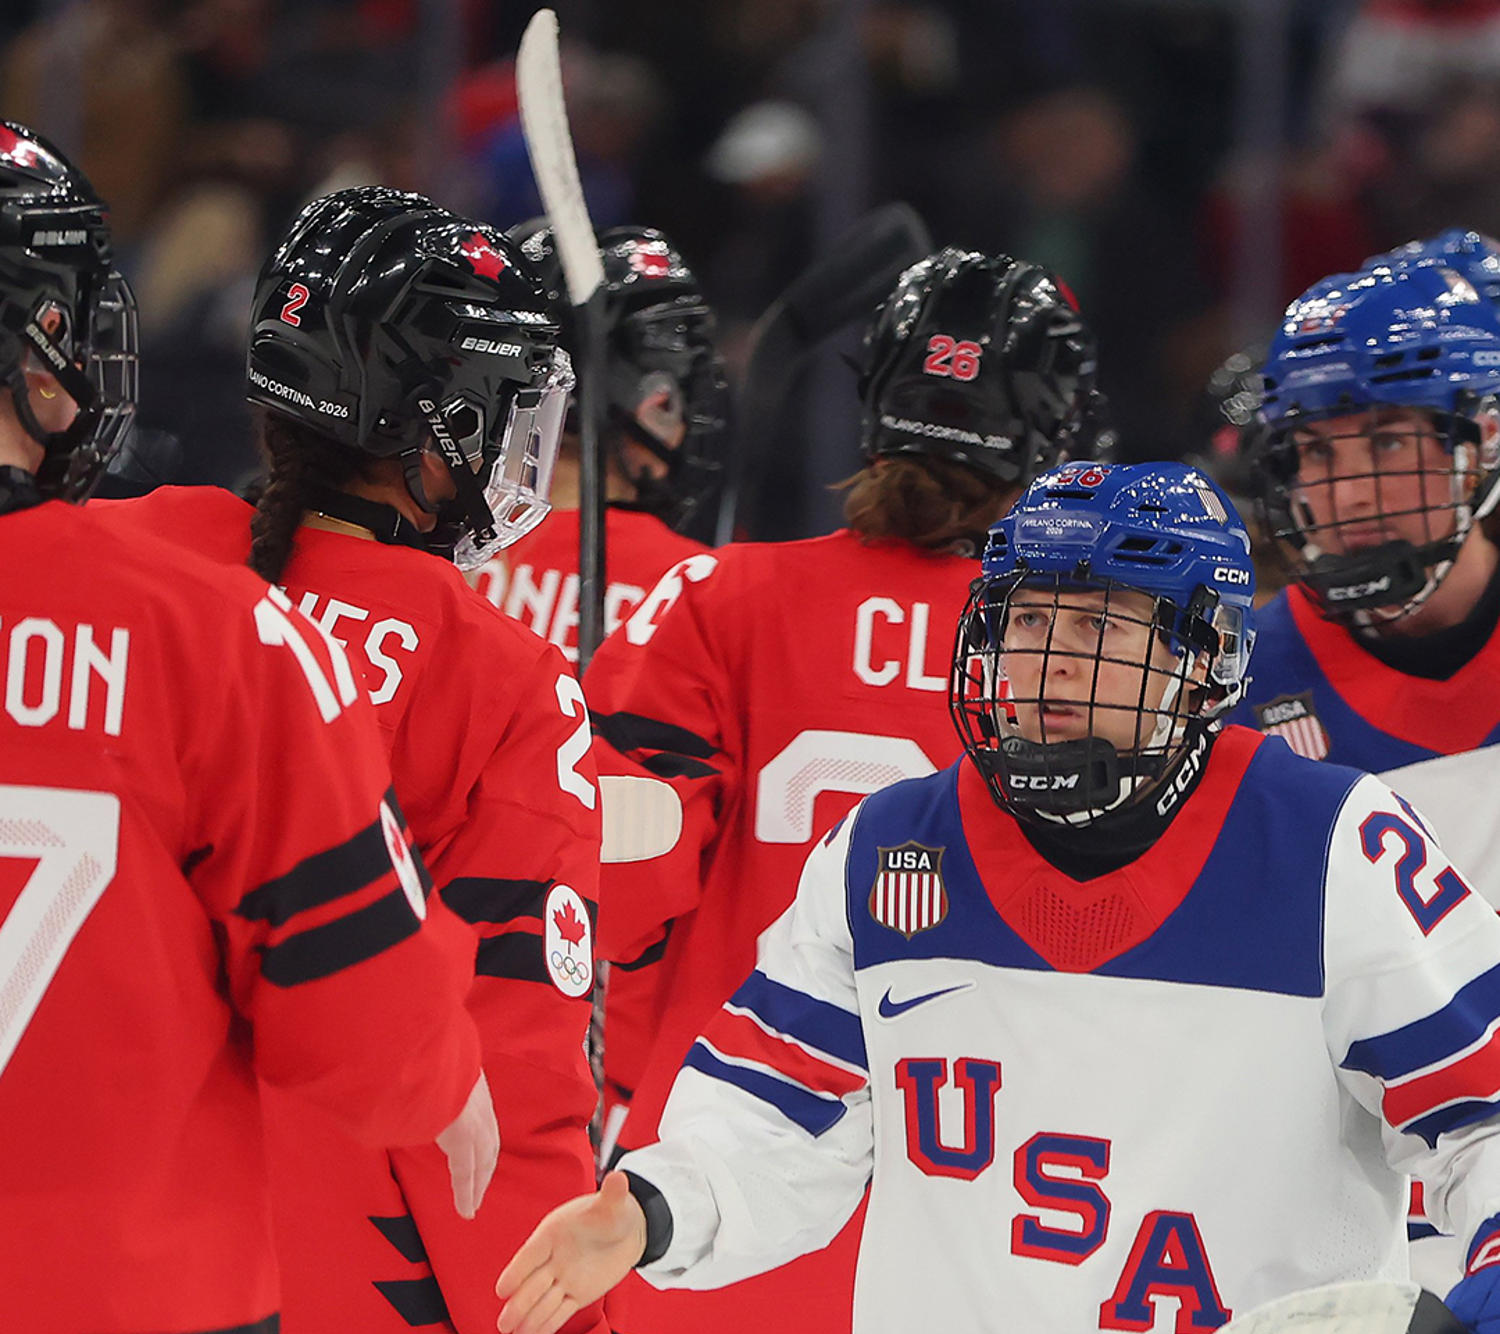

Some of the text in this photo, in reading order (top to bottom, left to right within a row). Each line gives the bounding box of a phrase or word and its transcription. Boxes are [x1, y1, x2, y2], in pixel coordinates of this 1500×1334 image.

[281, 282, 310, 327] 2
[25, 323, 67, 371] BAUER
[461, 337, 522, 358] BAUER
[923, 334, 983, 381] 26
[267, 380, 316, 410] CORTINA
[318, 401, 349, 418] 2026
[418, 399, 463, 467] BAUER
[1213, 567, 1250, 586] CCM
[0, 615, 130, 737] ON
[555, 673, 596, 811] 2
[1008, 773, 1080, 790] CCM
[886, 850, 932, 871] USA
[1358, 790, 1472, 938] 2
